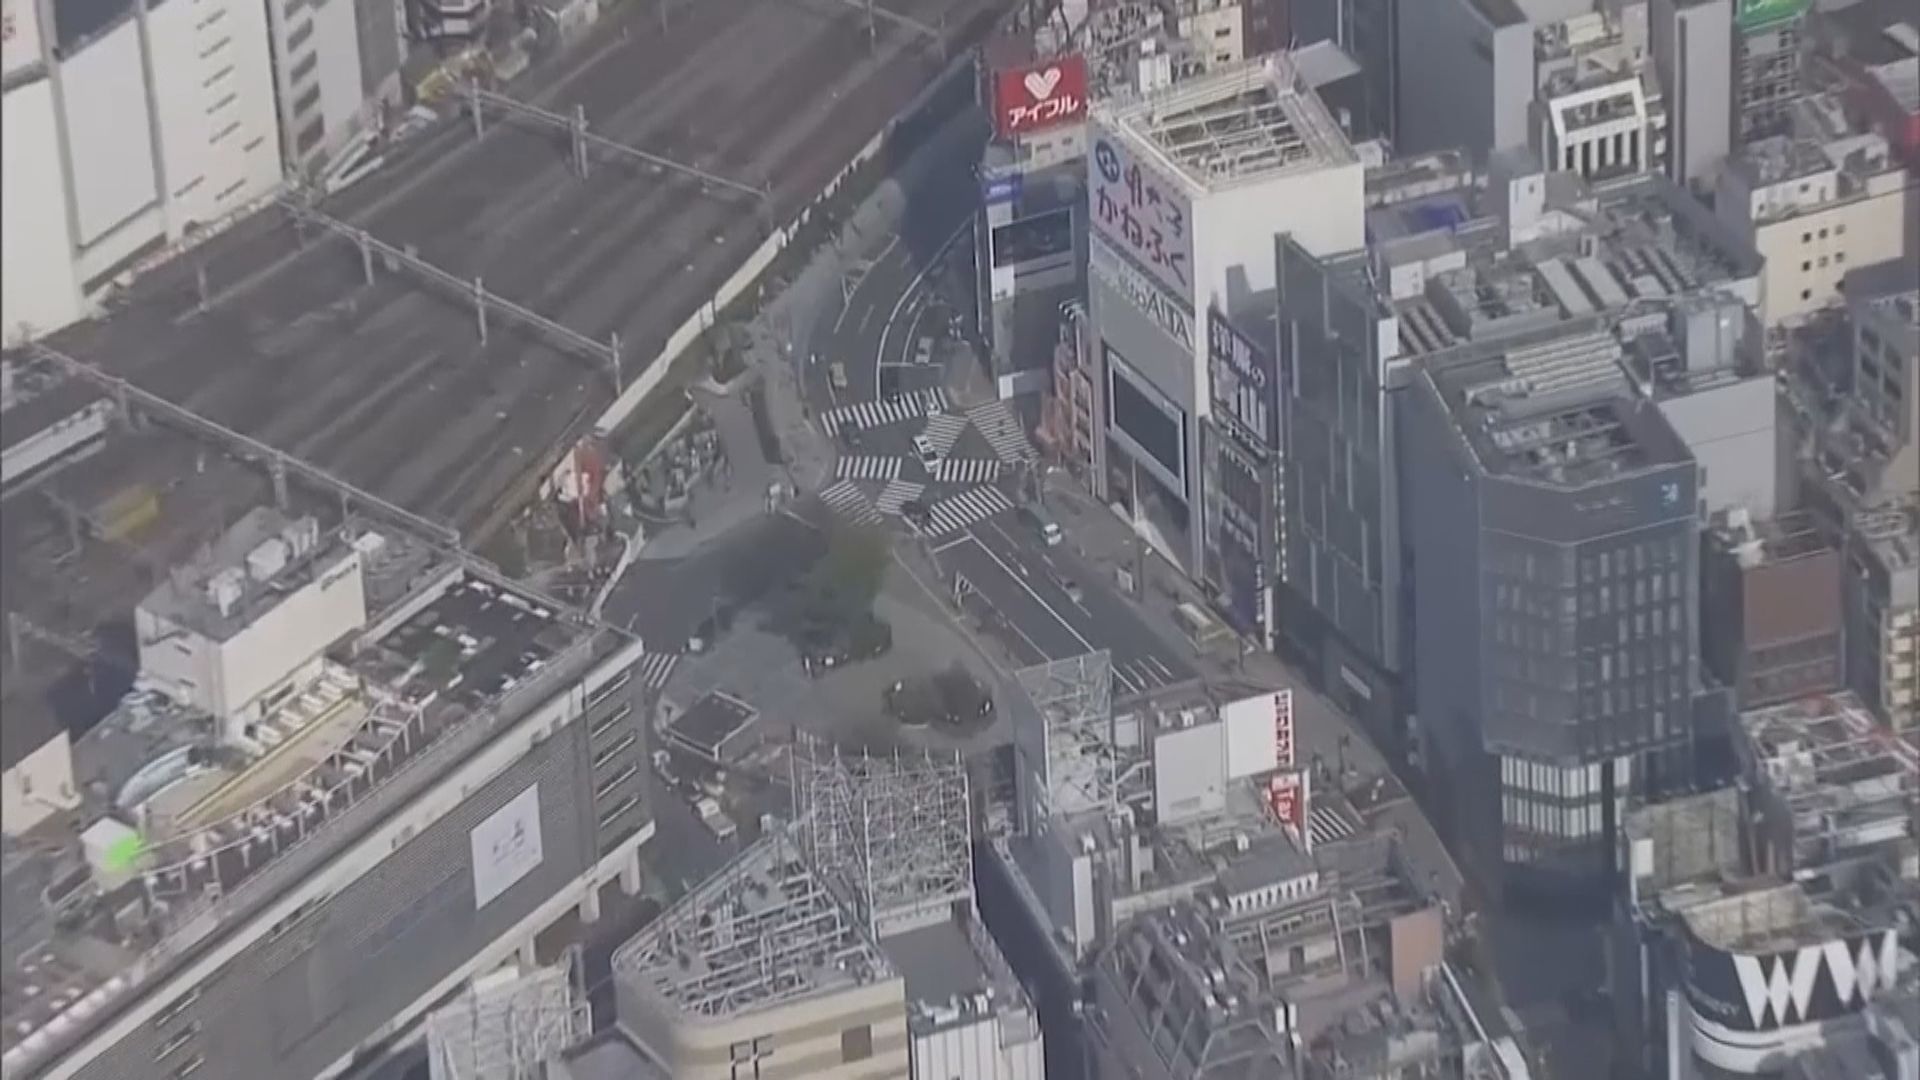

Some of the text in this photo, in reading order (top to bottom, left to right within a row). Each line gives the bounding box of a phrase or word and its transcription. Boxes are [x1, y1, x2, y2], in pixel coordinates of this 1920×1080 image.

[1008, 94, 1079, 127] アイフル
[1097, 184, 1187, 287] かねふく
[1146, 291, 1194, 351] ALTA
